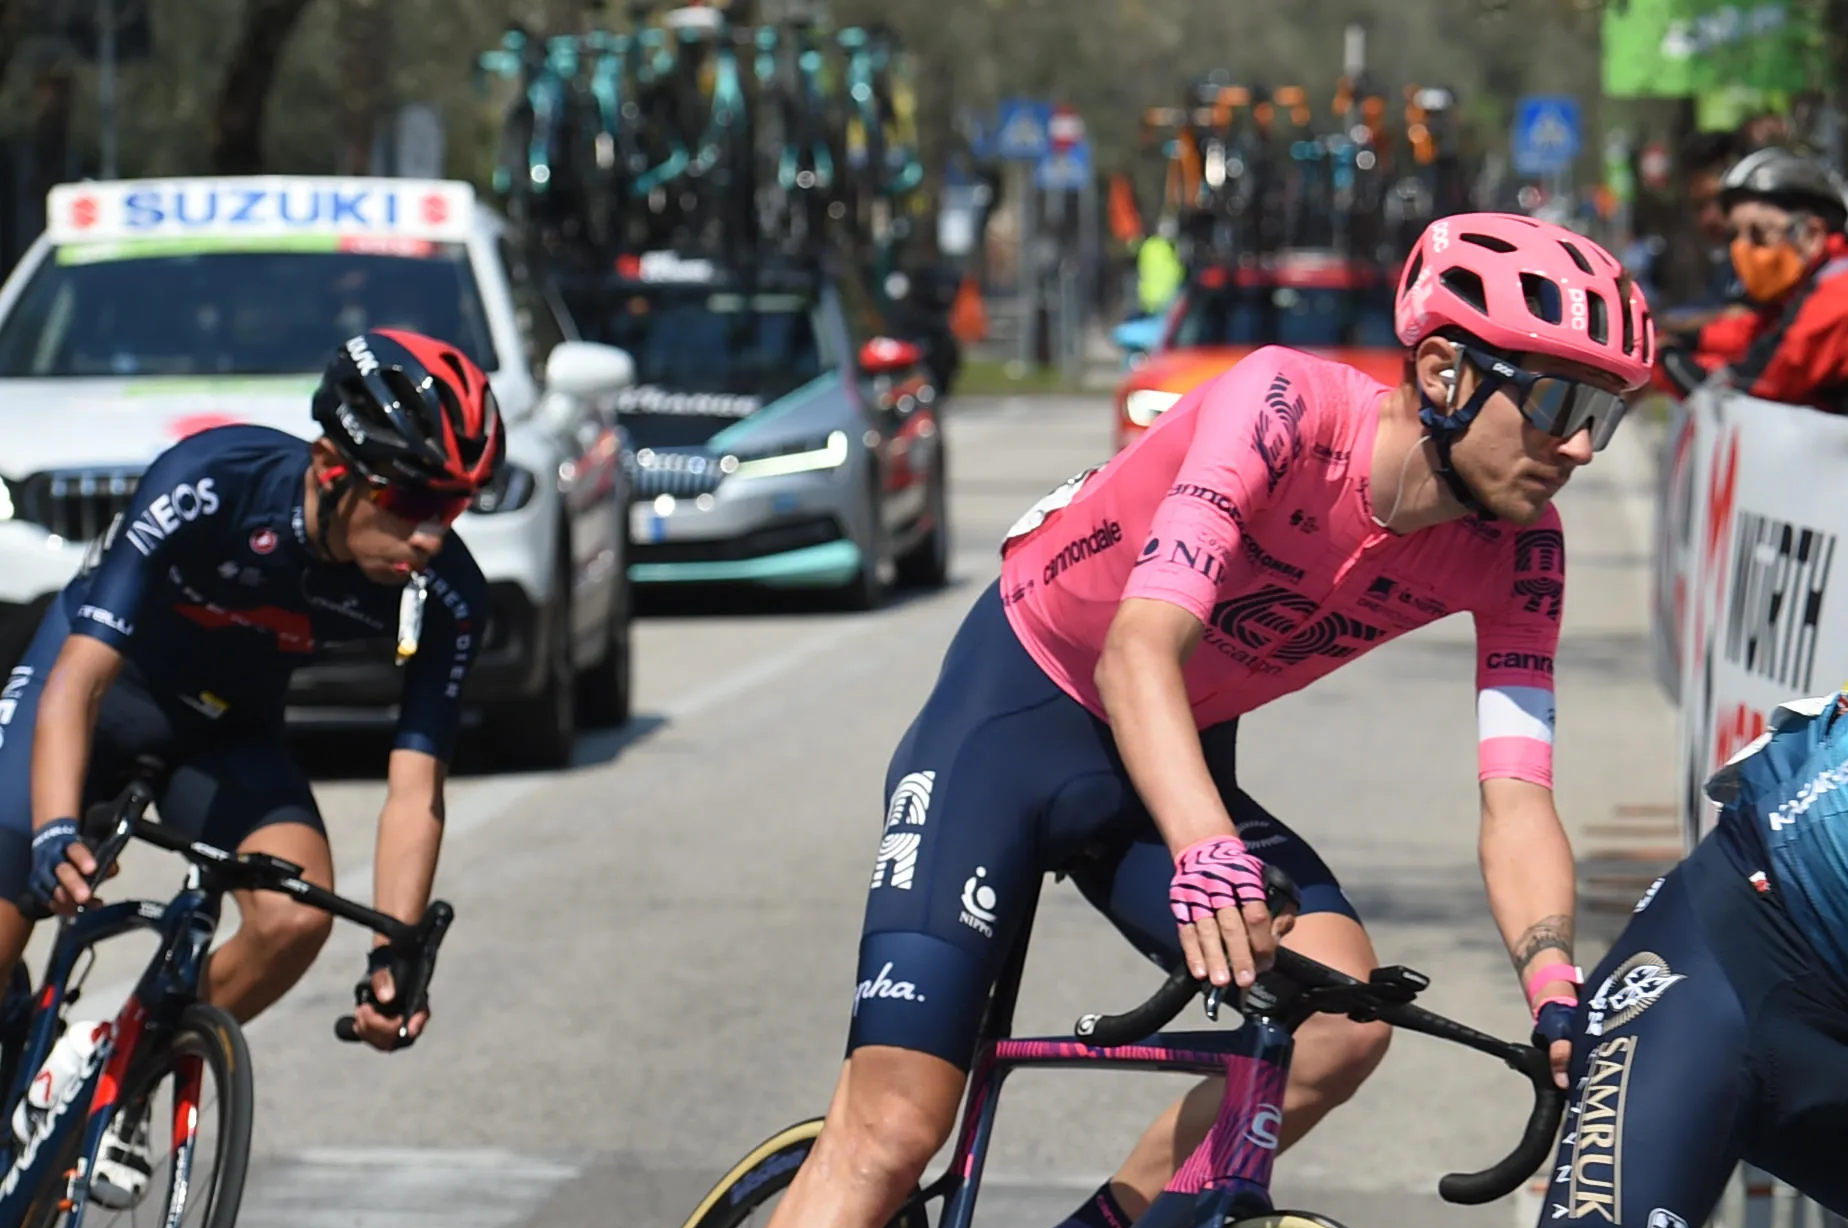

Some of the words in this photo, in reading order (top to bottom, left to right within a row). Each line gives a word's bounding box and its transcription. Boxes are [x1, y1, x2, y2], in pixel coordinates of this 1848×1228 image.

[126, 190, 400, 226] SUZUKI
[126, 476, 220, 557] INEOS
[1042, 518, 1123, 586] cannondale
[1573, 1036, 1629, 1223] SAMRUK
